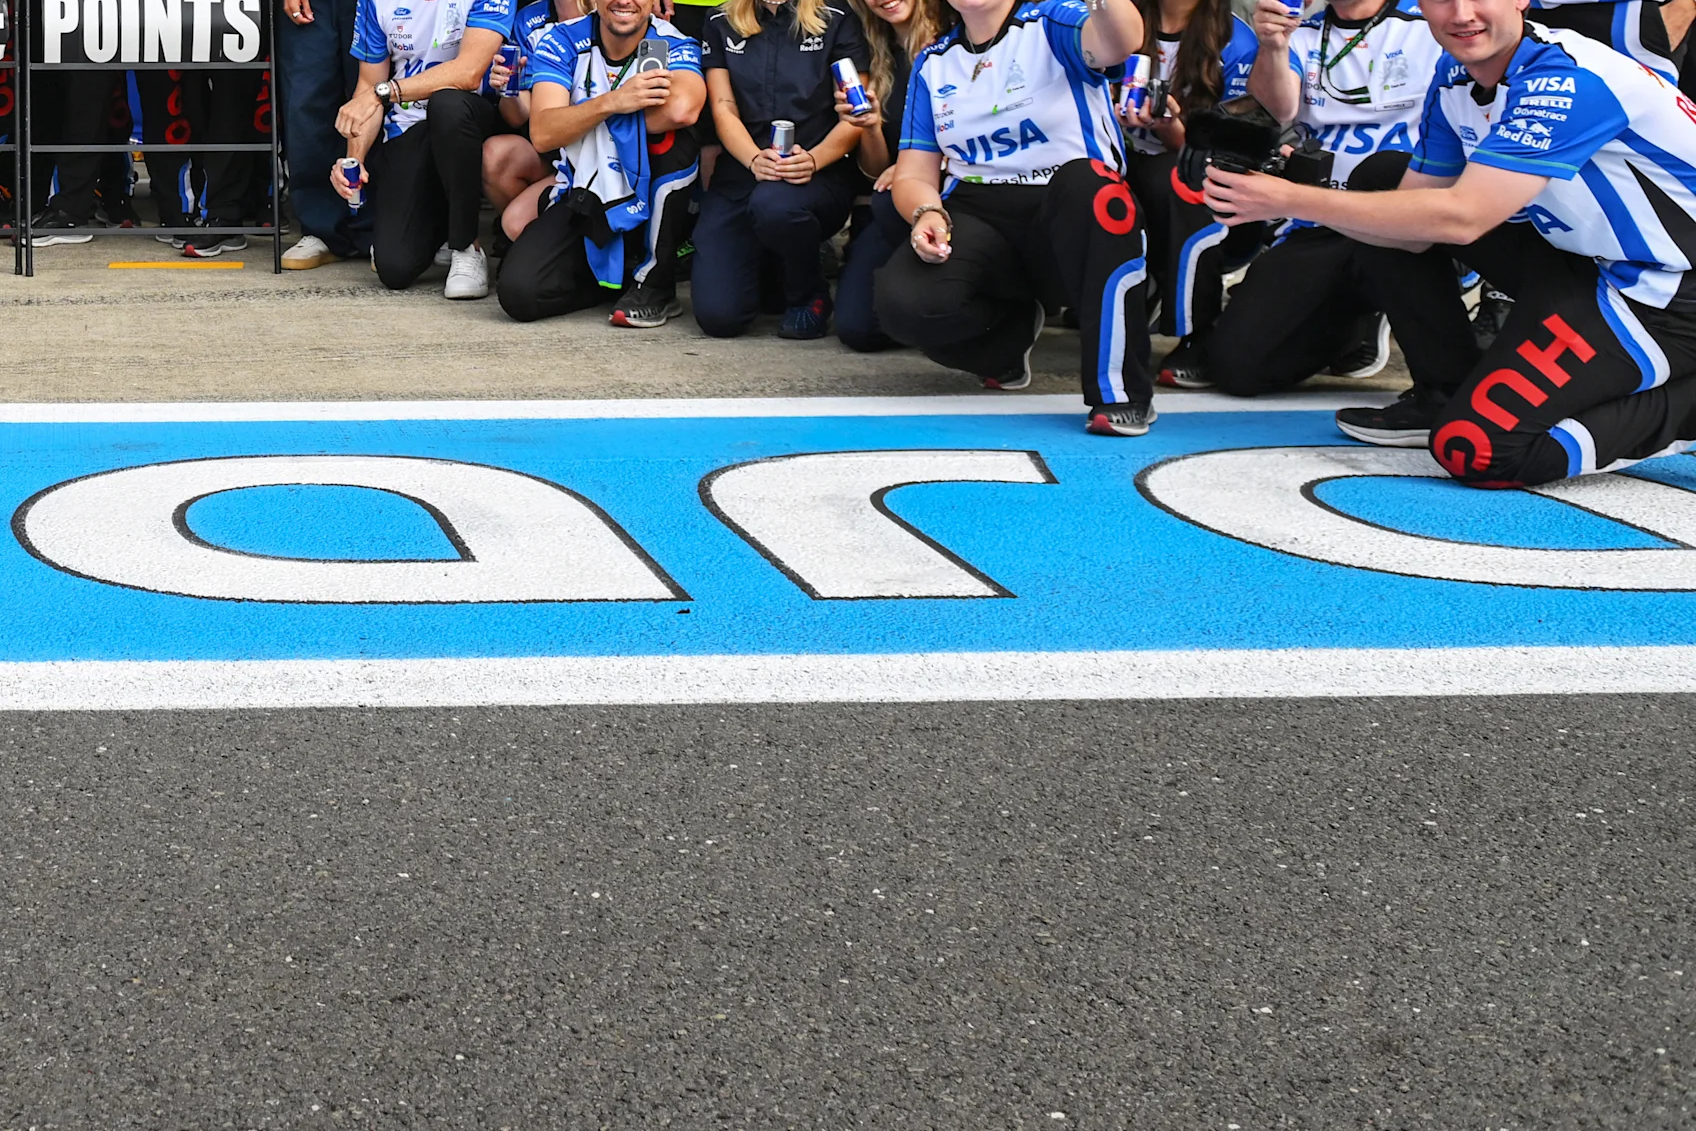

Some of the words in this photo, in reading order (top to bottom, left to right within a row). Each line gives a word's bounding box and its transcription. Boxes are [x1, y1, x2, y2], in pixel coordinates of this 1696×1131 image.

[391, 42, 414, 51] Mobil
[812, 42, 823, 51] Bull
[1384, 49, 1403, 59] VISA
[1524, 76, 1576, 94] VISA
[945, 118, 1049, 165] VISA
[1496, 125, 1520, 143] Red
[1523, 133, 1552, 151] Bull
[1430, 314, 1597, 479] HUG
